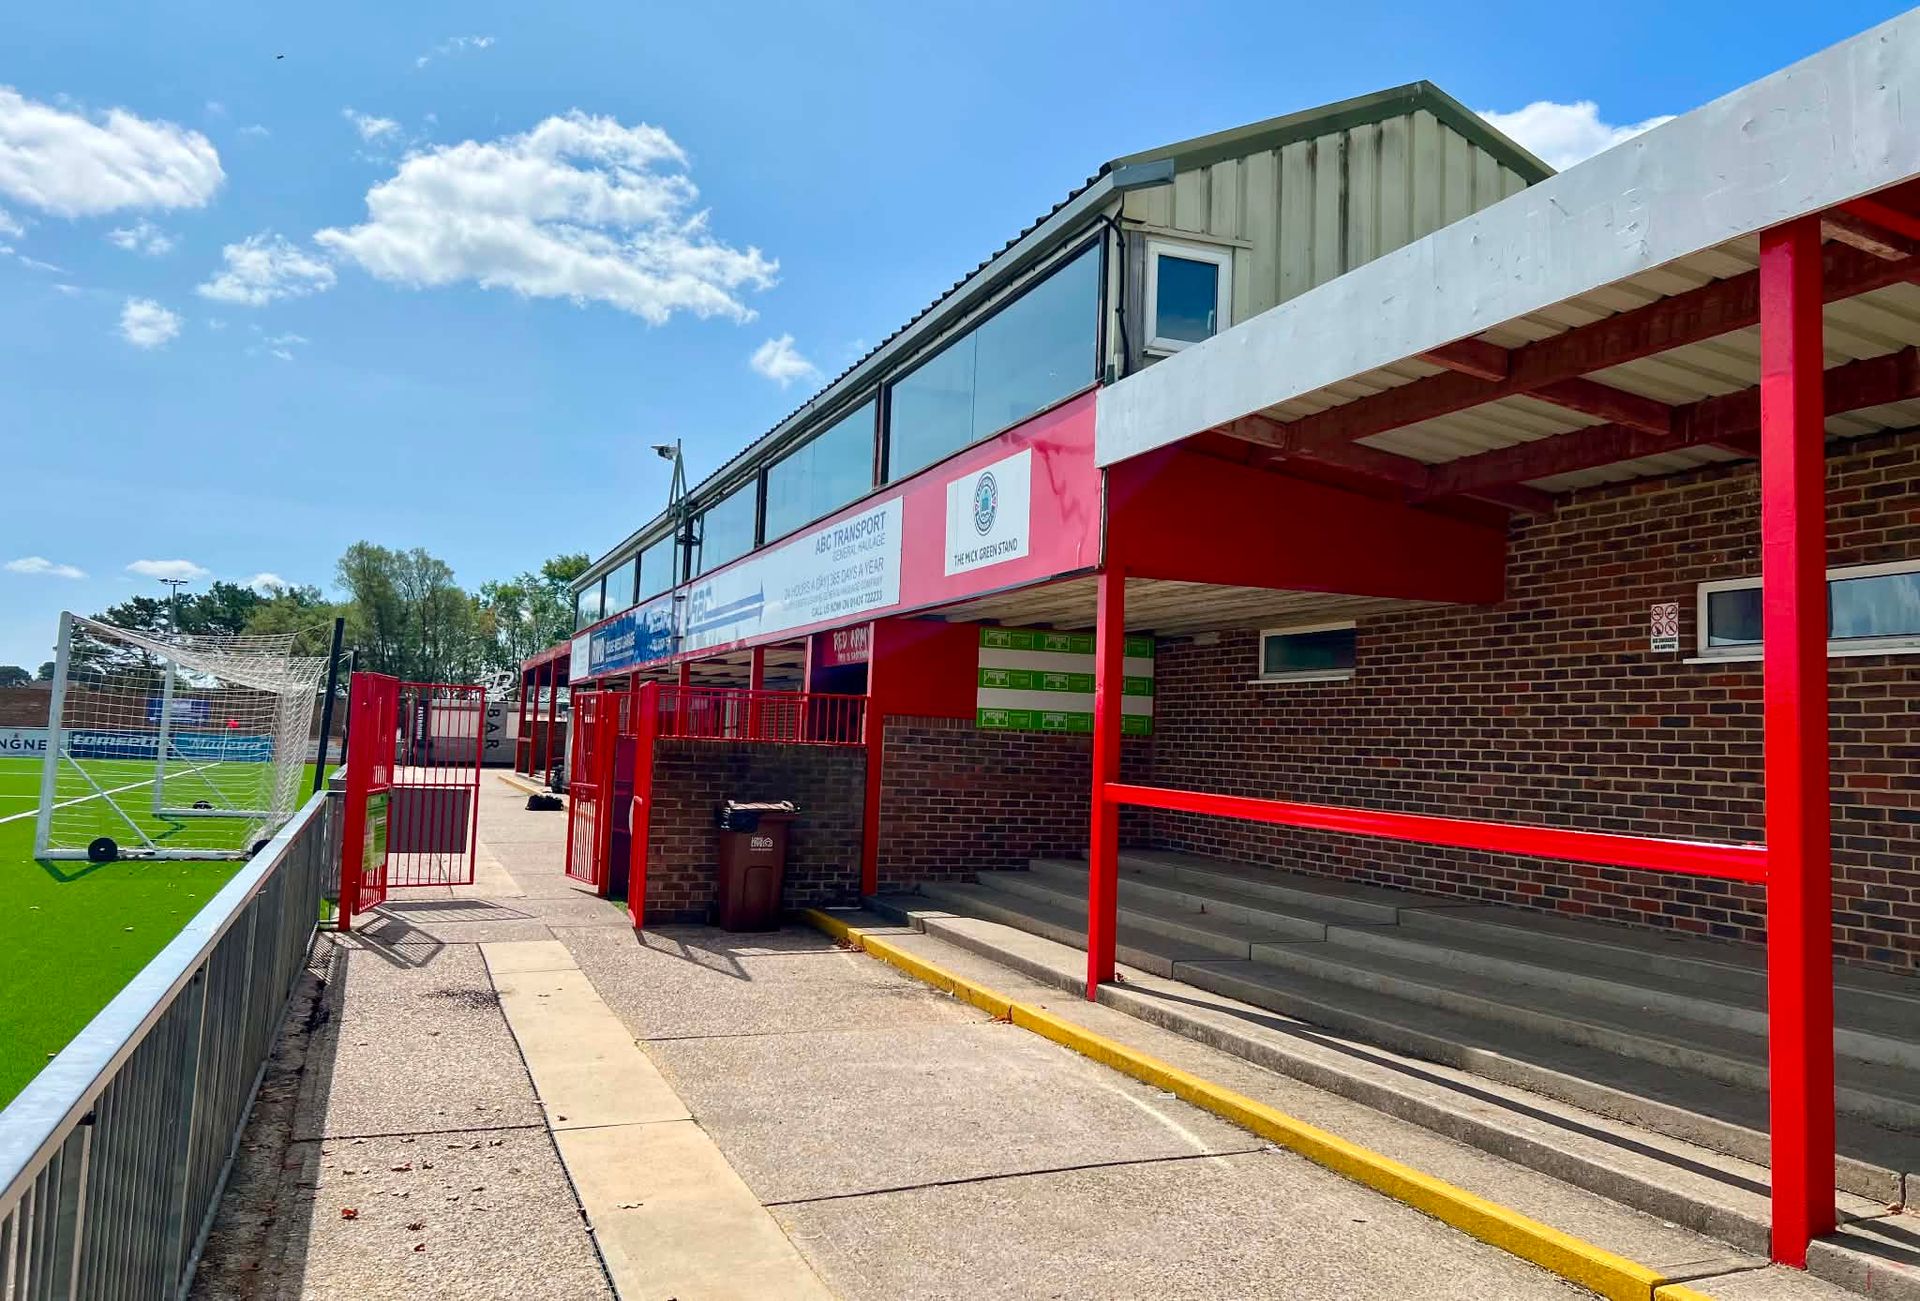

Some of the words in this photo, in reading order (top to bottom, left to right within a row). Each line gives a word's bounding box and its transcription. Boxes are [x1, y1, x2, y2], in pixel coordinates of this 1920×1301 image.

[815, 534, 832, 555] ABC
[833, 511, 886, 548] TRANSPORT
[832, 545, 856, 562] GENERAL
[858, 533, 886, 551] HAULAGE
[954, 553, 965, 567] THE
[965, 549, 979, 564] MICK
[979, 544, 998, 560] GREEN
[998, 538, 1018, 556] STAND
[841, 565, 857, 583] DAYS
[865, 556, 884, 575] YEAR
[811, 606, 823, 617] CALL
[833, 630, 848, 652] RED
[850, 626, 870, 652] ARMY
[486, 708, 500, 750] BAR
